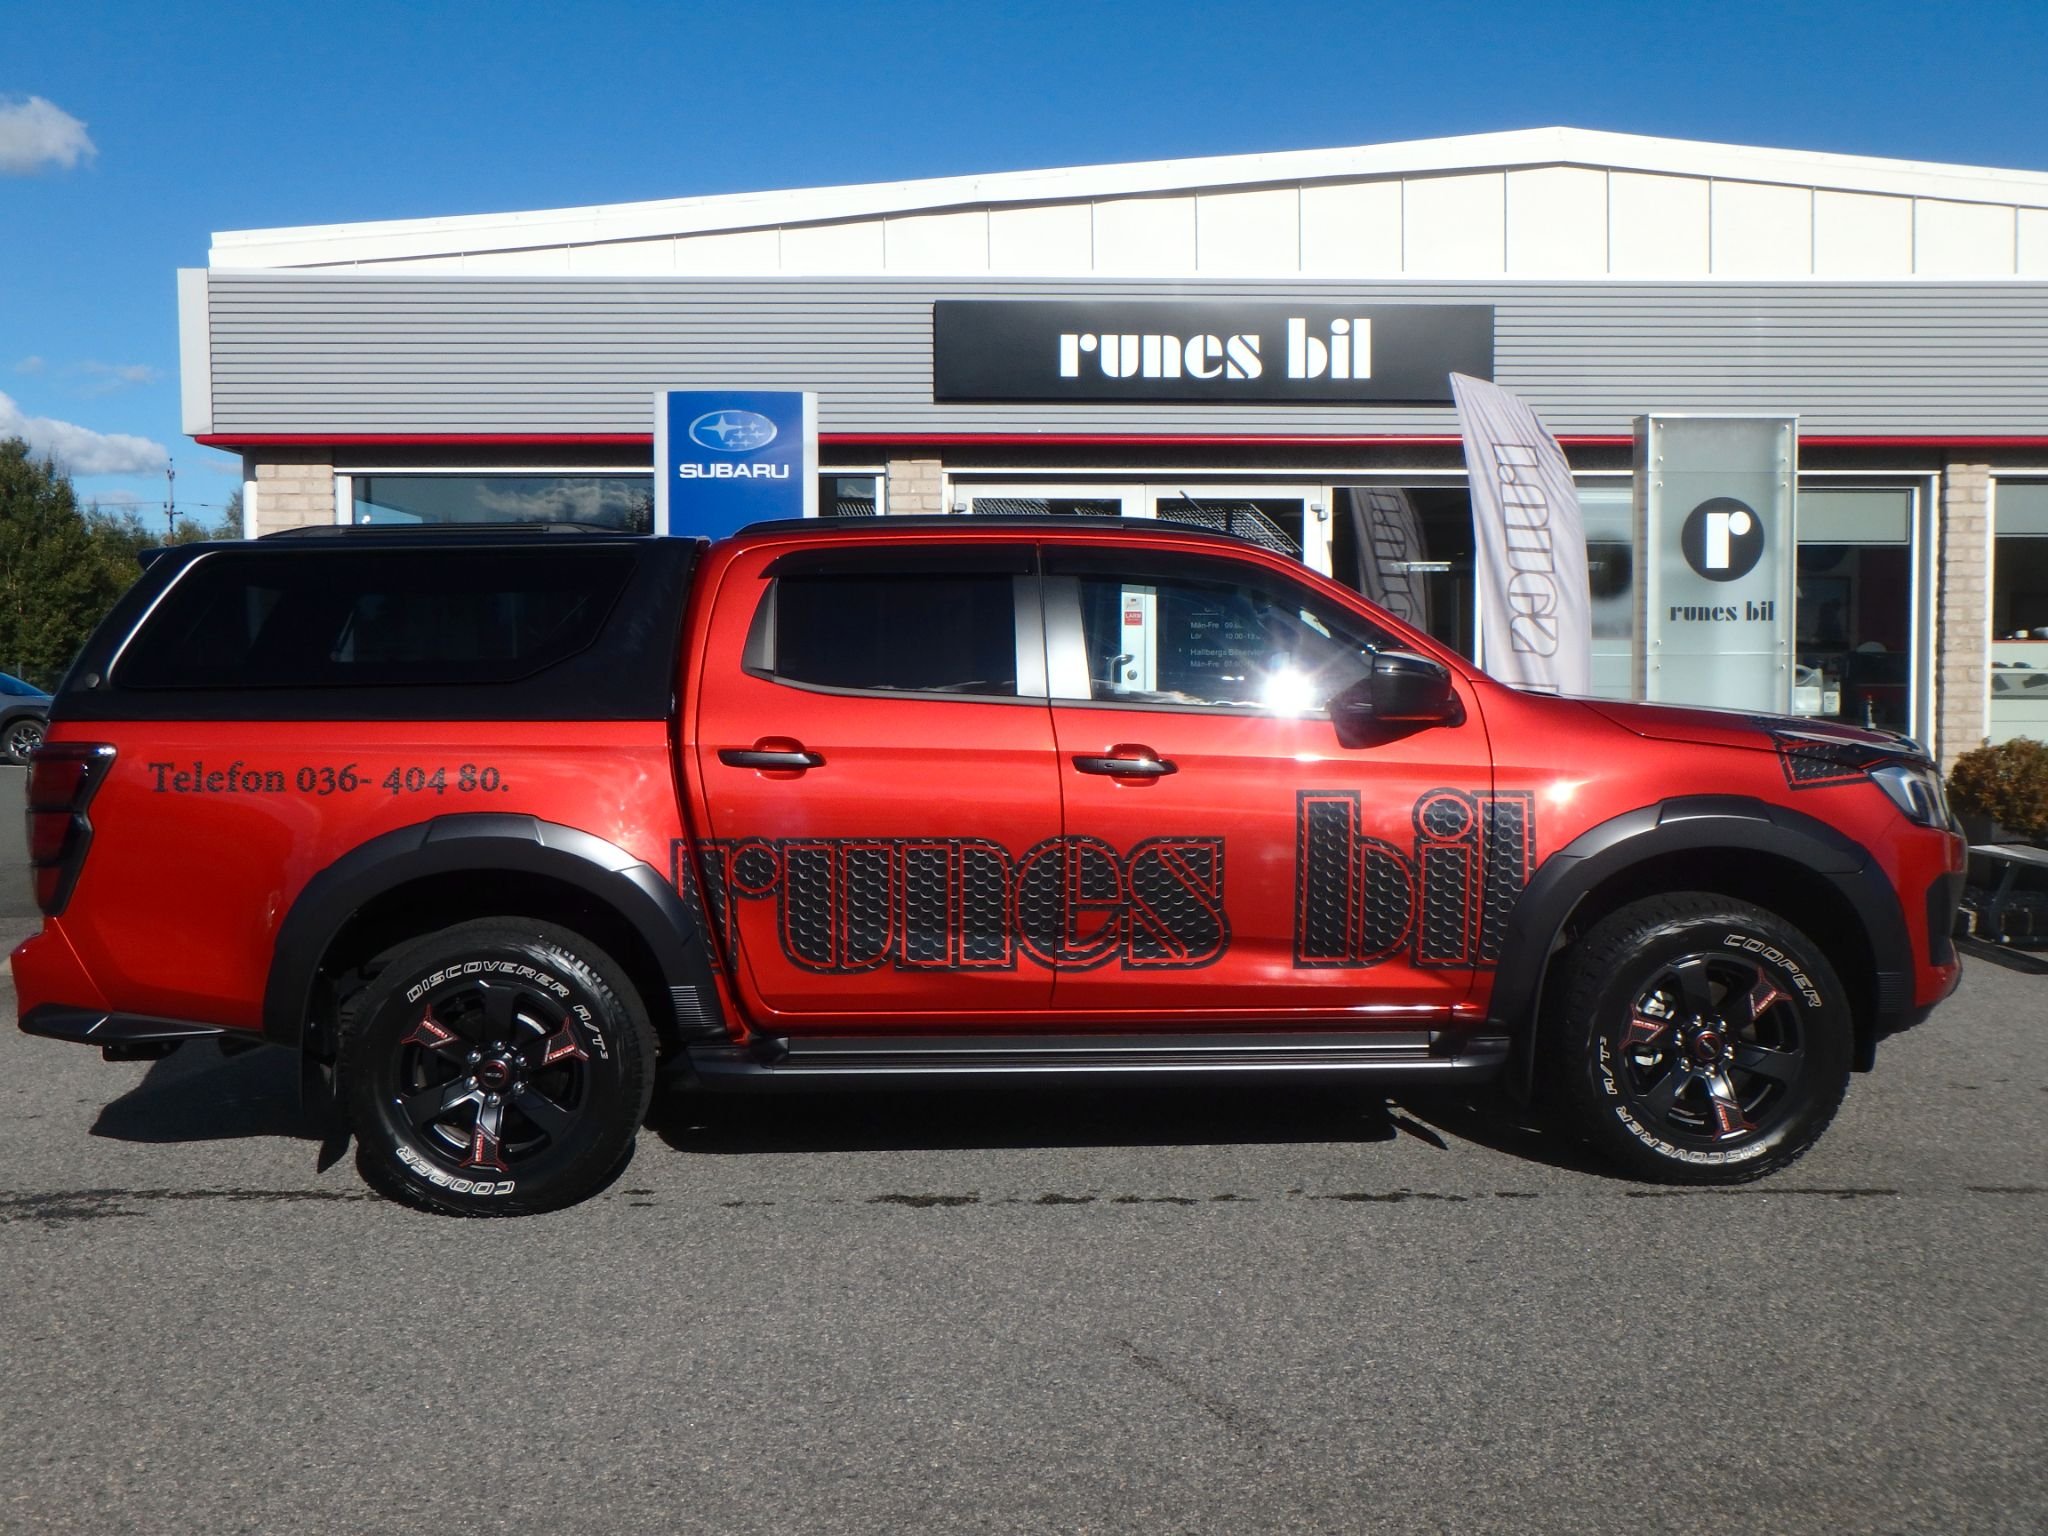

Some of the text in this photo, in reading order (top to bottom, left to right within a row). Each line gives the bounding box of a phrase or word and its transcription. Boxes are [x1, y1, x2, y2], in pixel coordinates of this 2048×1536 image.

[1060, 318, 1371, 379] runes bil
[679, 463, 789, 479] SUBARU
[1705, 510, 1751, 569] r
[1670, 600, 1774, 621] runes bil
[148, 761, 286, 793] Telefon
[296, 764, 373, 796] 036-
[382, 766, 448, 795] 404
[671, 788, 1536, 974] runes bil
[406, 960, 570, 1004] DISCOVERER
[1723, 934, 1822, 1008] COOPER
[1615, 1105, 1767, 1165] DISCOVERER
[395, 1145, 515, 1196] COOPER
